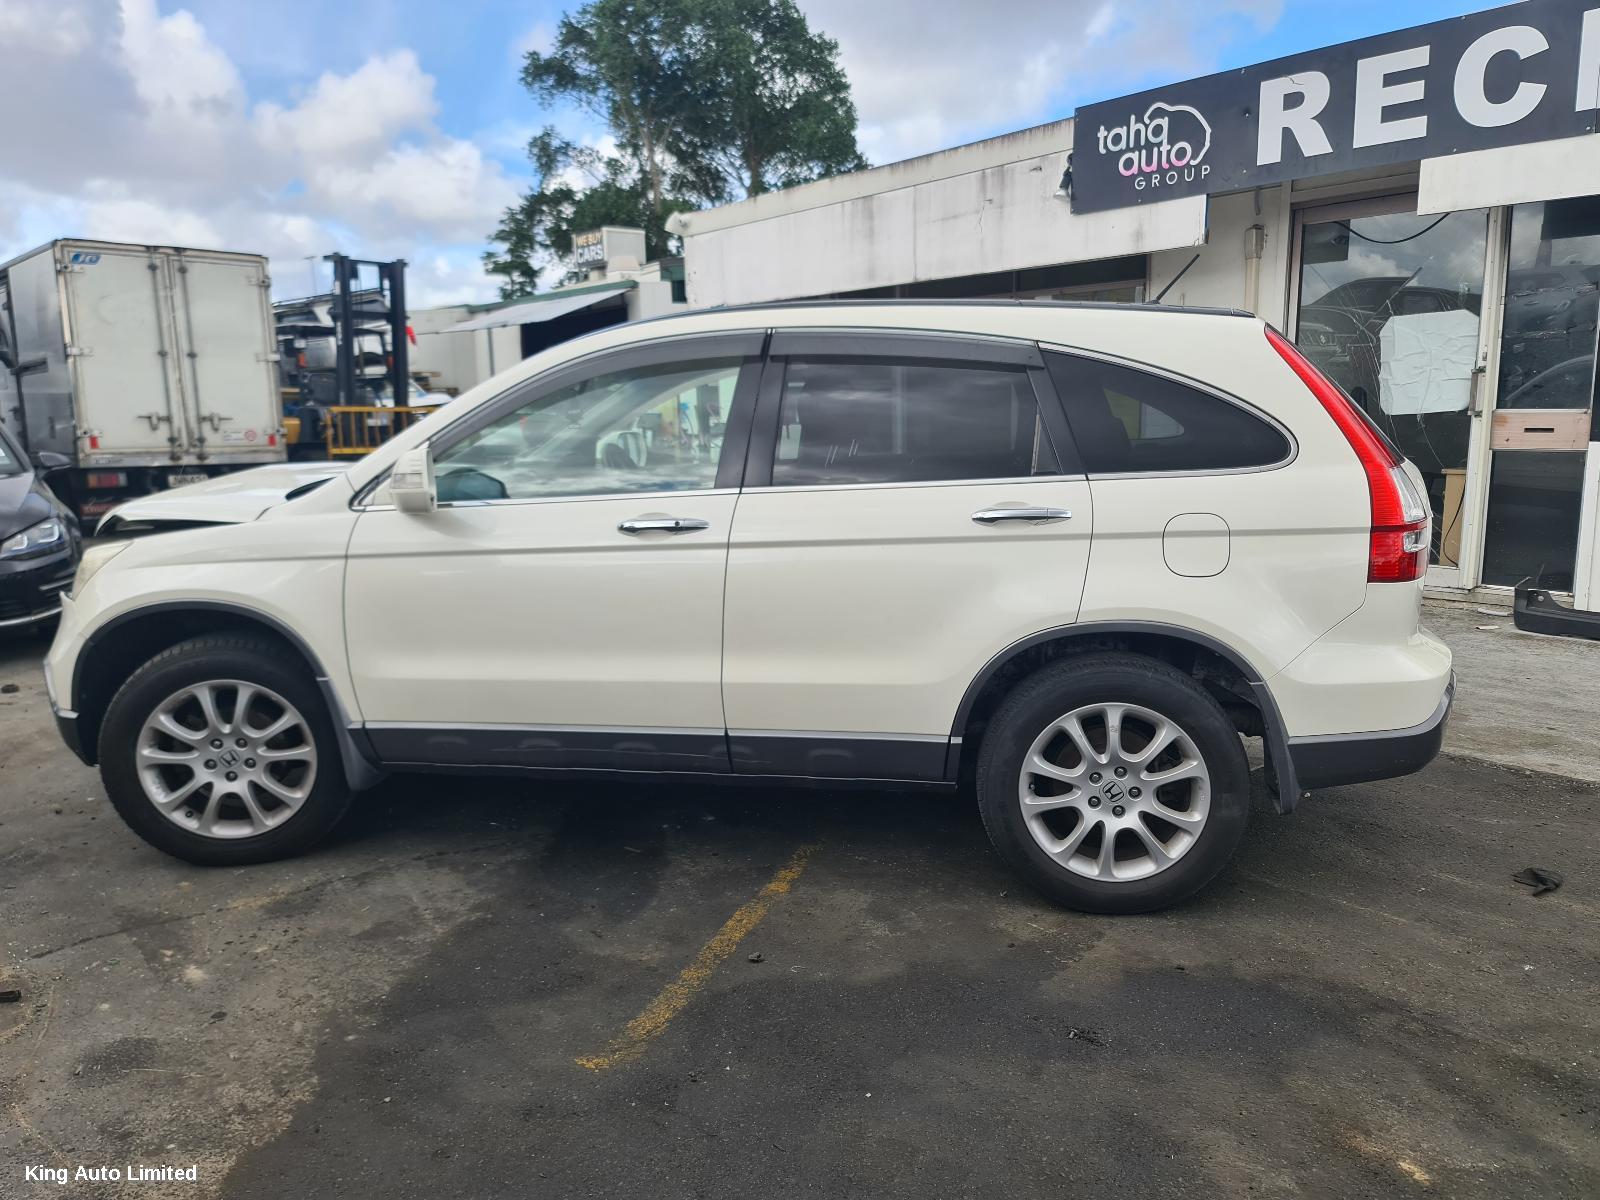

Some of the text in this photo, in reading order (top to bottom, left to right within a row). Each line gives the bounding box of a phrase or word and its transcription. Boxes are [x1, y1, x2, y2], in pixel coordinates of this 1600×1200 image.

[1257, 7, 1600, 166] REC
[1097, 114, 1169, 154] taha
[1118, 141, 1192, 176] auto
[1134, 165, 1210, 190] GROUP
[577, 244, 603, 263] CARS
